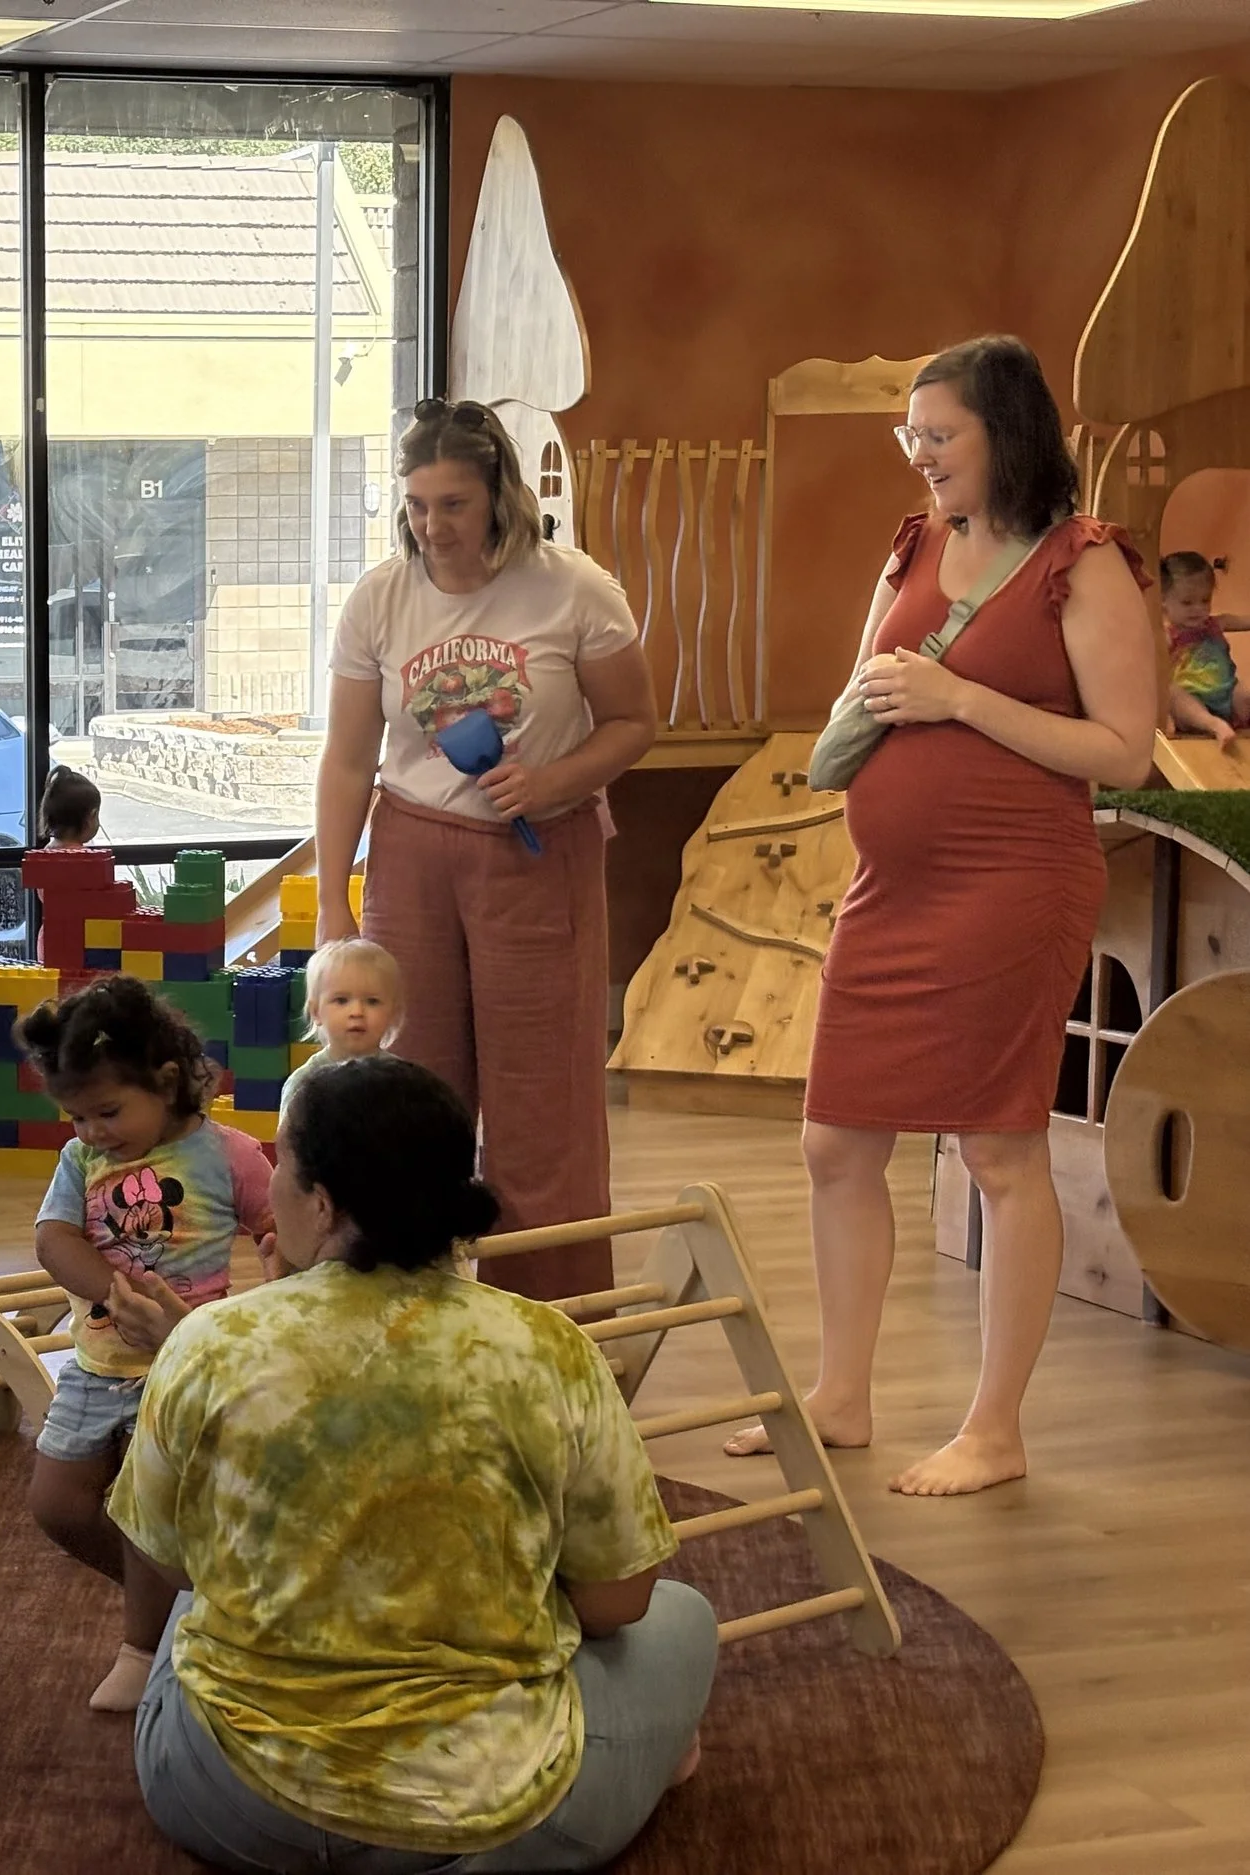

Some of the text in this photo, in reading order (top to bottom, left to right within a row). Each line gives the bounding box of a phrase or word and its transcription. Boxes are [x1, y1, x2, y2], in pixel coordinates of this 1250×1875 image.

[140, 479, 163, 499] B1
[1, 536, 24, 547] ELIT
[407, 636, 518, 688] CALIFORNIA
